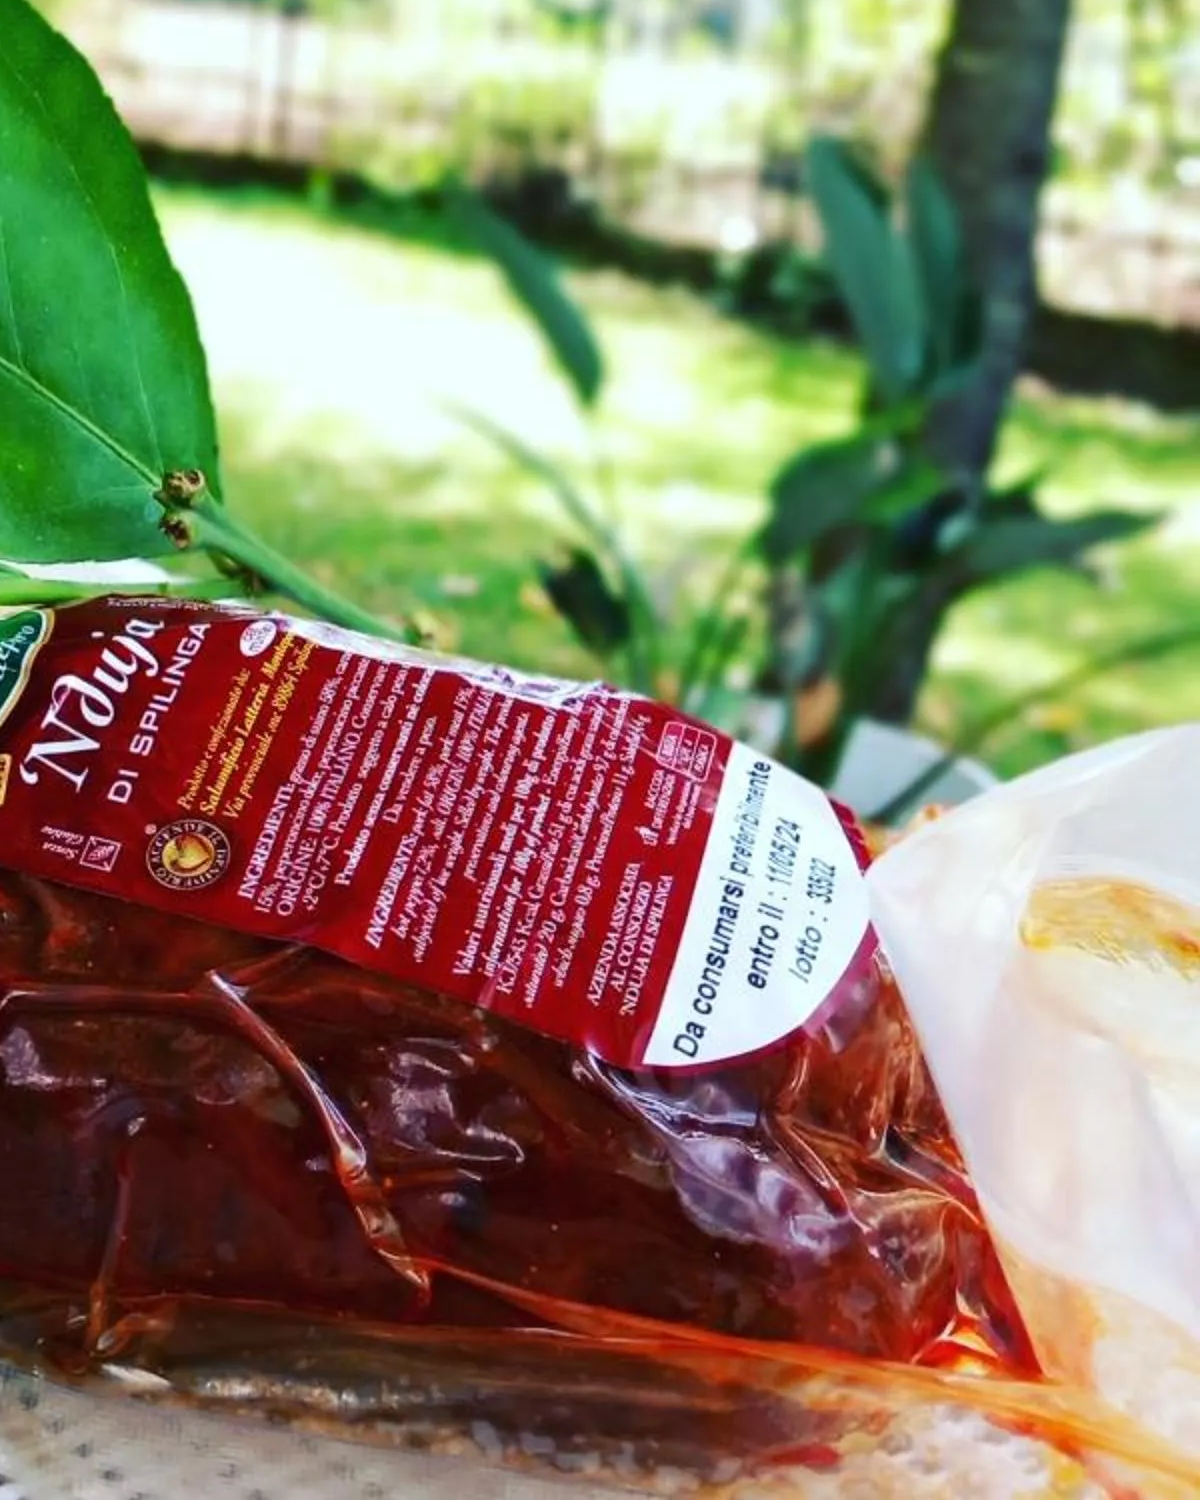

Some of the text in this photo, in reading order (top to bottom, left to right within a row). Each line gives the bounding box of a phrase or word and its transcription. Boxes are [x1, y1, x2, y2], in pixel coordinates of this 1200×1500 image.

[107, 769, 139, 804] DI
[130, 622, 211, 757] SPILINGA
[238, 784, 294, 897] INGREDIENTI:
[365, 834, 417, 947] INGREDIENTS:
[766, 818, 800, 884] 11/05/24
[587, 863, 639, 1005] AZIENDA ASSOCIATA
[610, 881, 651, 991] AL CONSORZIO
[672, 1021, 706, 1058] Da
[693, 877, 743, 1014] consumarsi
[729, 761, 770, 875] preferibilmente
[747, 924, 779, 989] entro
[757, 901, 783, 920] il
[789, 926, 821, 982] lotto
